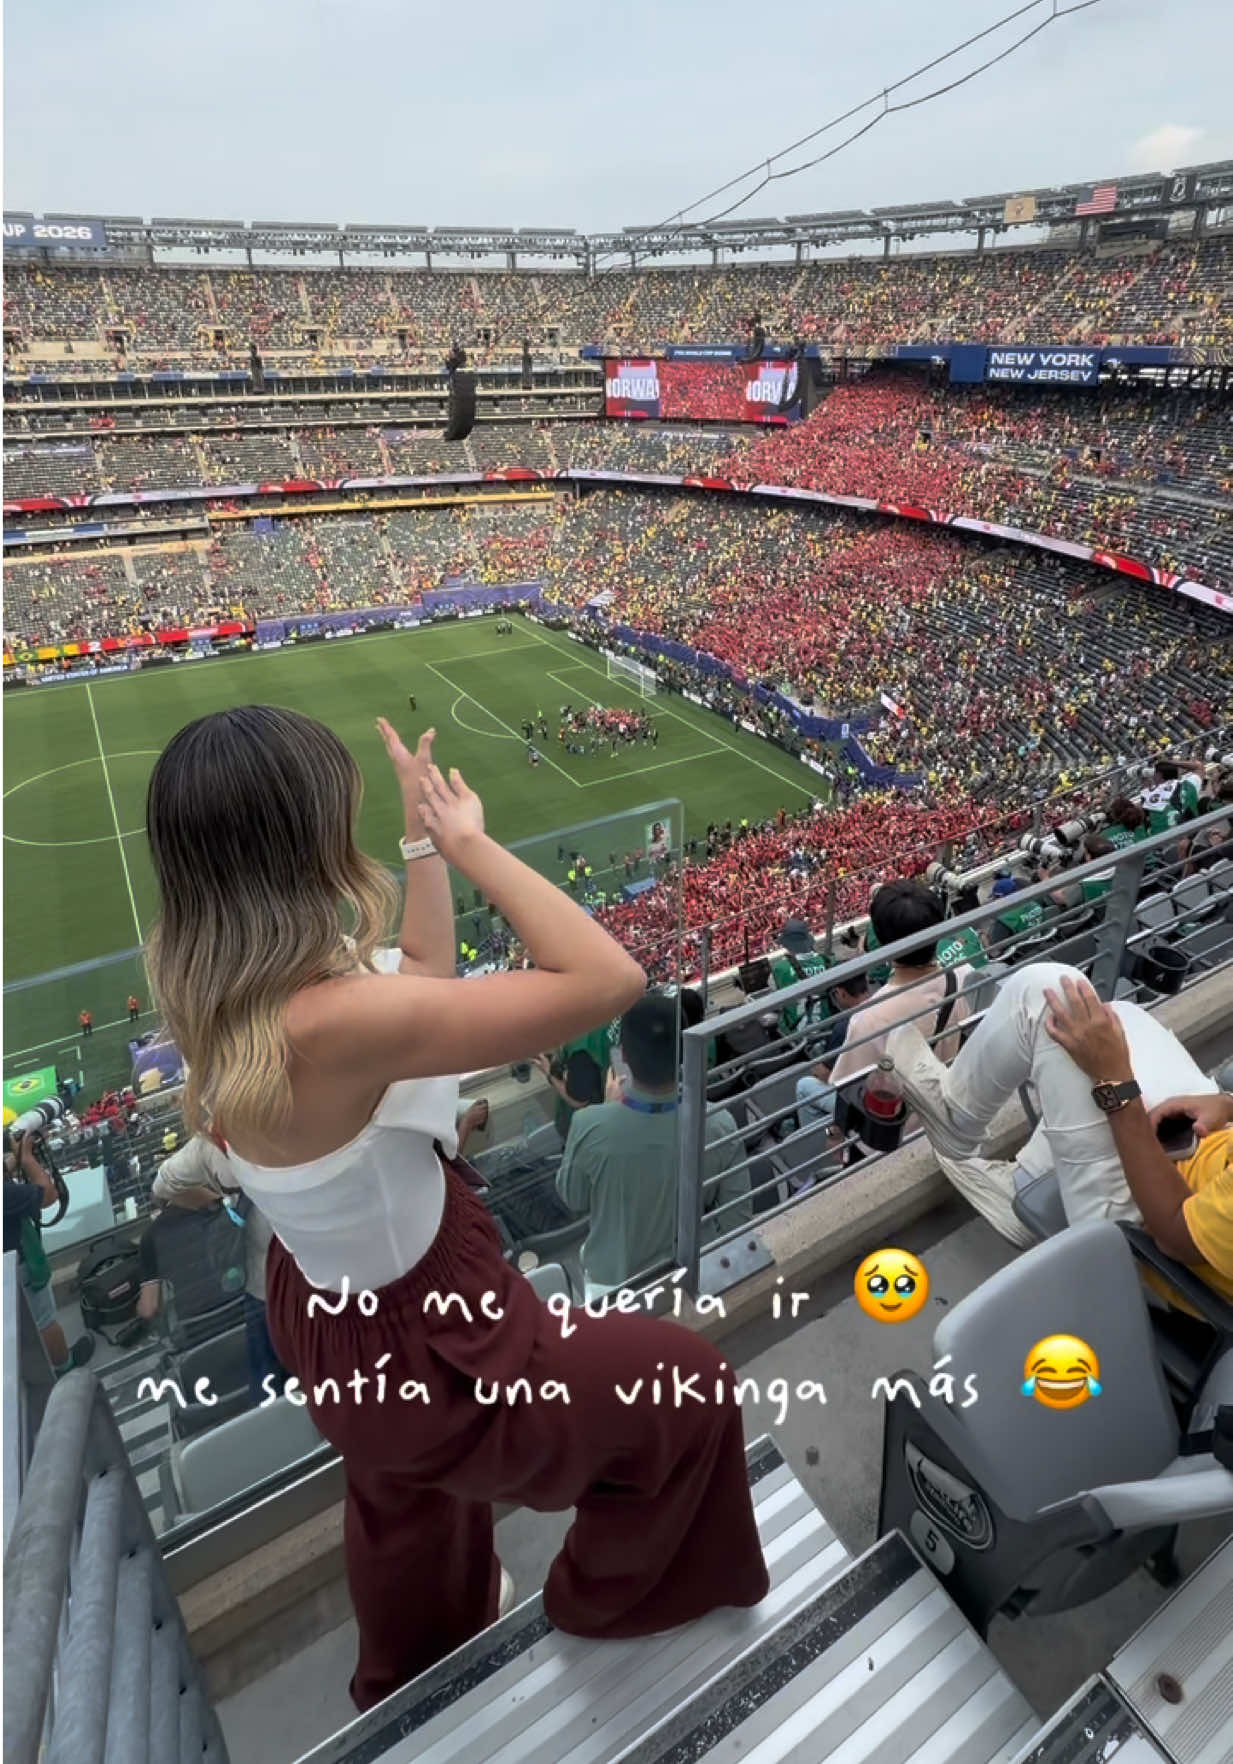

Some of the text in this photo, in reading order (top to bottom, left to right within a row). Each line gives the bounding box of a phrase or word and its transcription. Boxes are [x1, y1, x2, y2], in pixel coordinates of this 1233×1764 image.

[32, 224, 93, 240] 2026
[991, 352, 1096, 367] NEW YORK
[989, 368, 1092, 382] NEW JERSEY
[924, 1530, 939, 1552] 5
